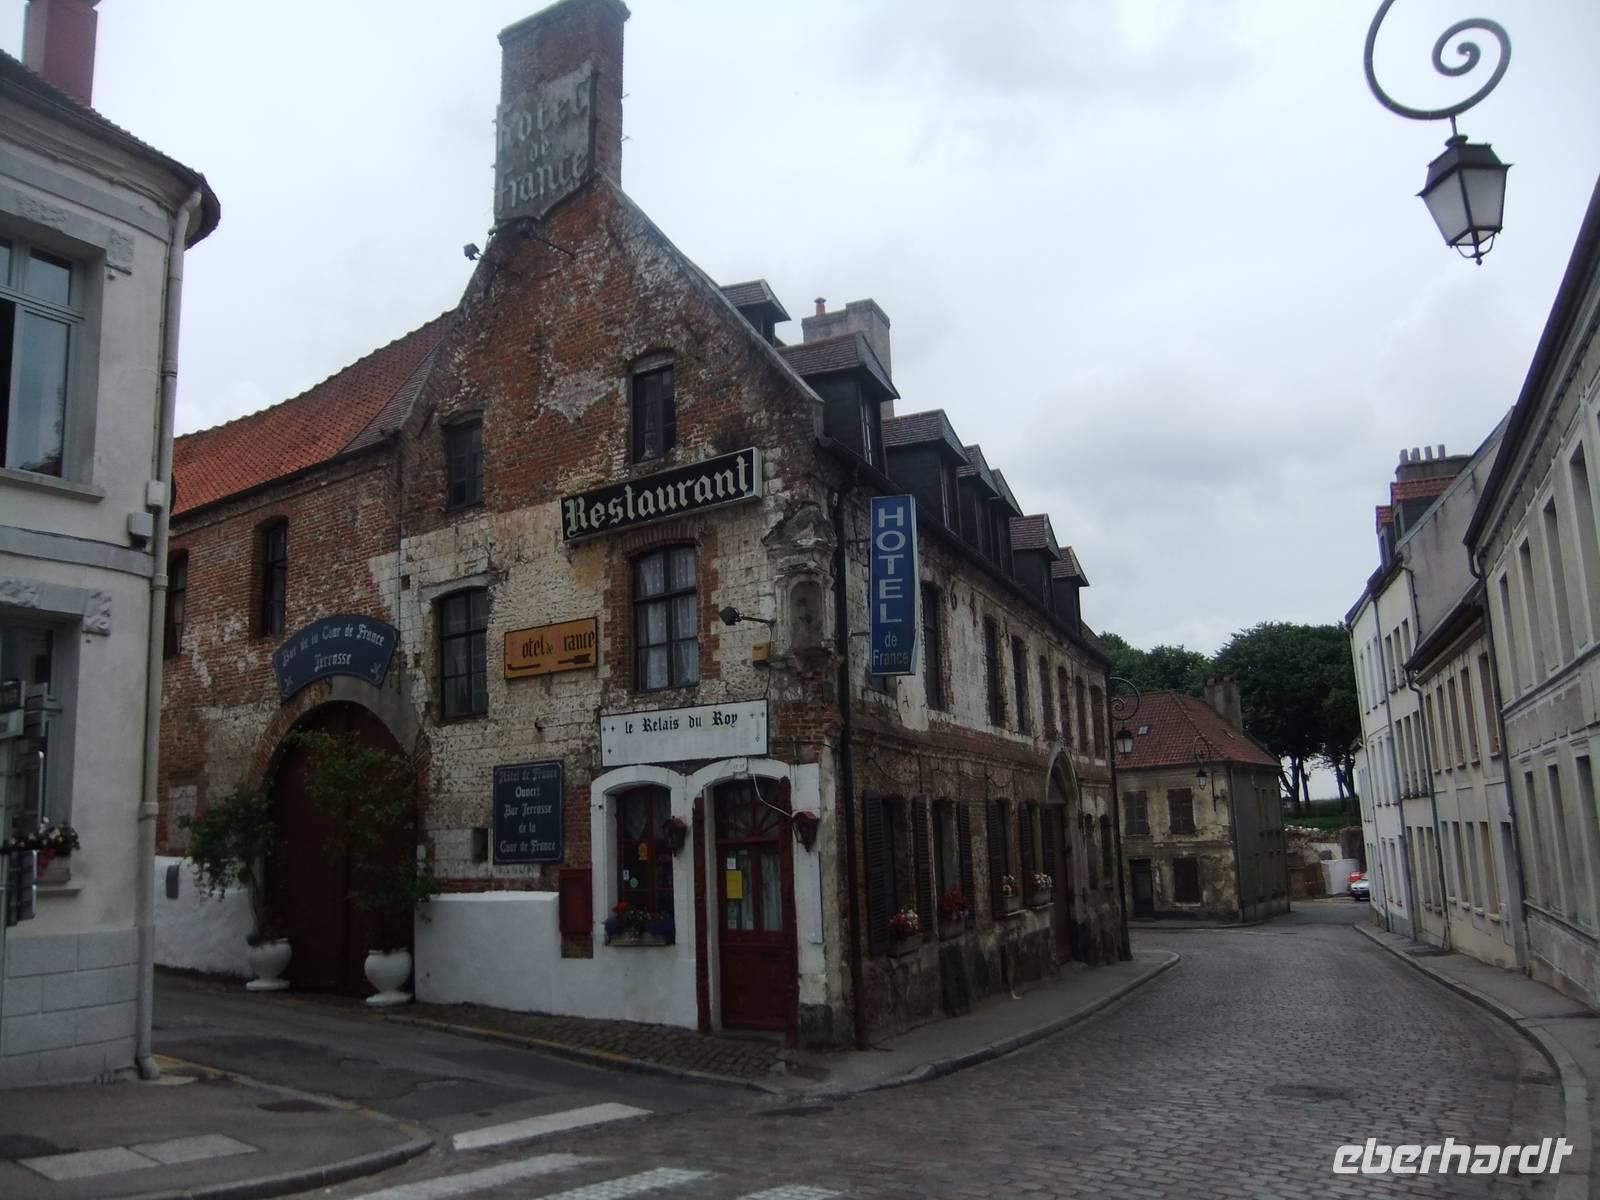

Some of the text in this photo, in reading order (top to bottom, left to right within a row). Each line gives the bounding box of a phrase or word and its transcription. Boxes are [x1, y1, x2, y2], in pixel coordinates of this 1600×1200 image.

[564, 455, 749, 538] Restaurant
[875, 507, 906, 623] HOTEL
[344, 624, 354, 637] de
[356, 623, 385, 646] France
[884, 632, 897, 648] de
[314, 653, 352, 672] Terrasse
[873, 649, 909, 665] France
[625, 711, 738, 734] le Relais du Roy
[522, 803, 553, 816] Terrasse
